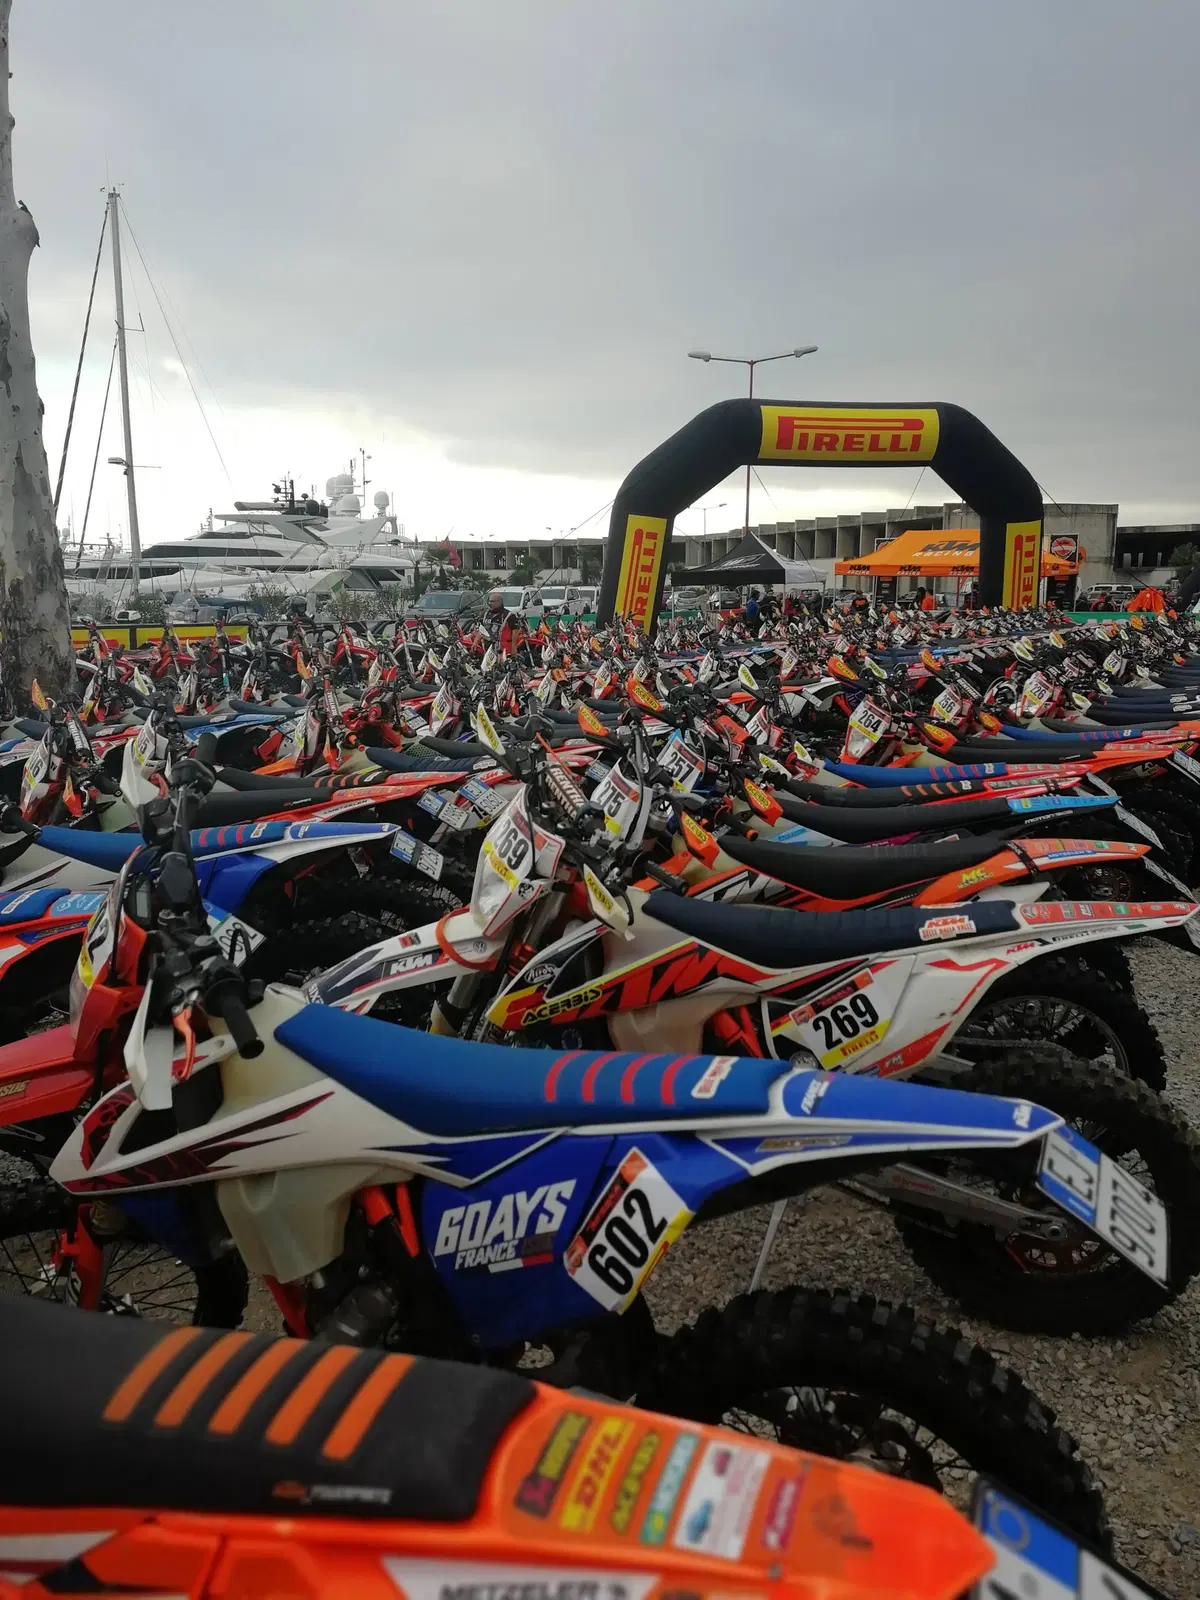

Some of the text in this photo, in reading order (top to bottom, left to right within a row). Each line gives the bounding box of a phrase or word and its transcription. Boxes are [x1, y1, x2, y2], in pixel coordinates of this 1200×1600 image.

[775, 416, 925, 452] PIRELLI
[858, 710, 883, 733] 264
[667, 751, 695, 783] 257
[597, 781, 626, 818] 275
[492, 818, 530, 871] 269
[389, 953, 433, 975] KTM
[812, 993, 880, 1050] 269
[839, 1029, 880, 1057] PIRELLI
[434, 1179, 577, 1256] 6DAYS
[454, 1239, 519, 1270] FRANCE
[587, 1188, 668, 1296] 602
